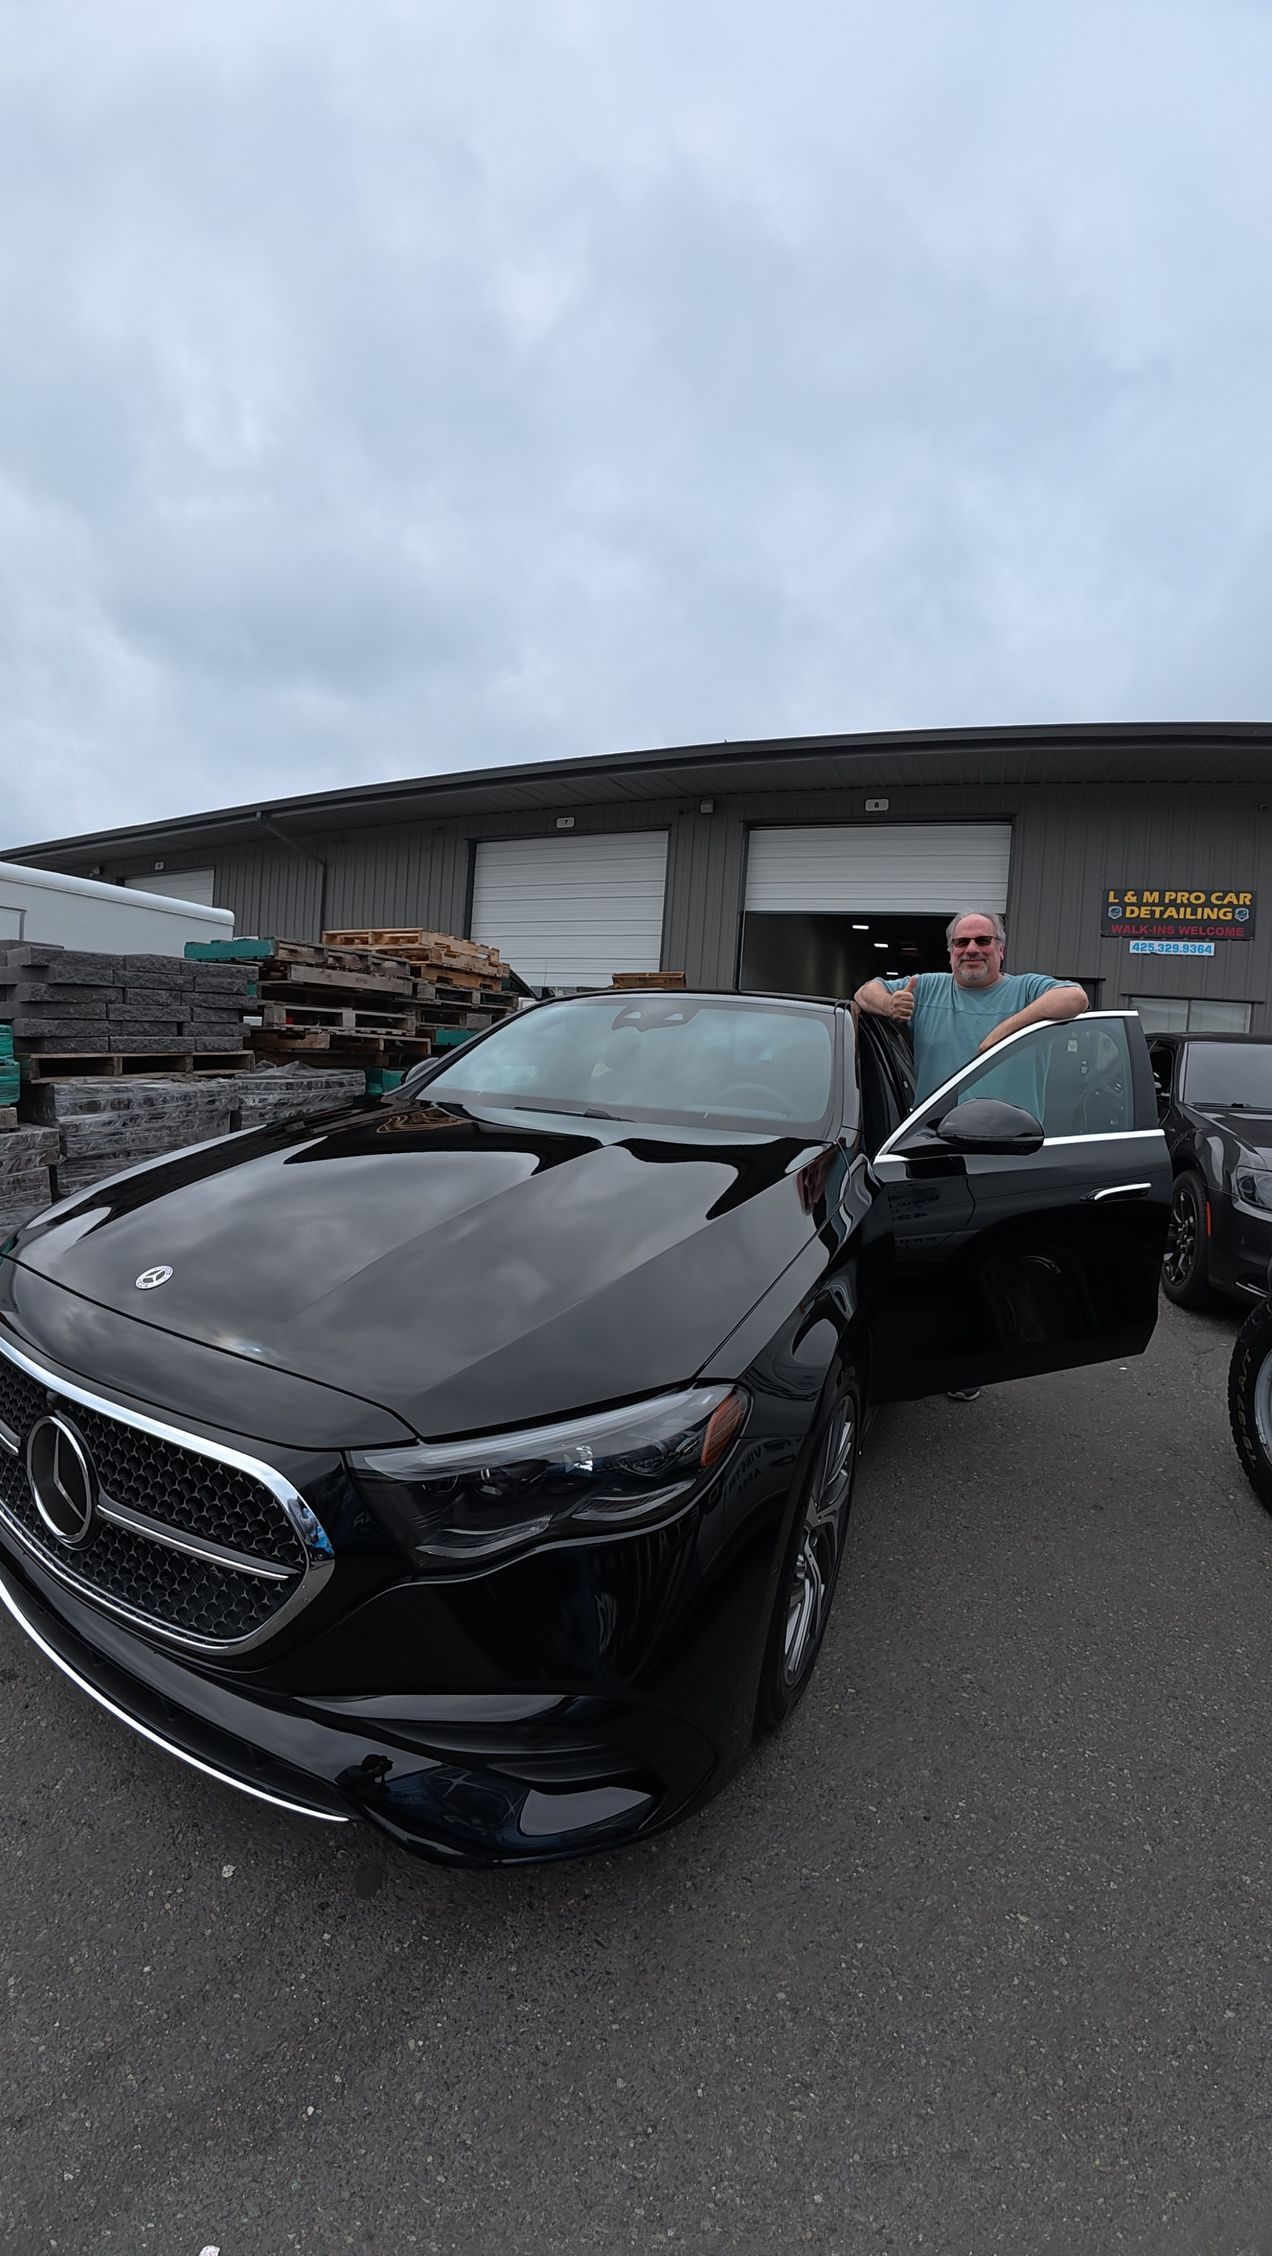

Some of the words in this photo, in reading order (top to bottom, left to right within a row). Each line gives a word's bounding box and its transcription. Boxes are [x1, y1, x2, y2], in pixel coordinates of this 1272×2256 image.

[1108, 890, 1120, 903] L
[1124, 891, 1138, 903] &
[1142, 891, 1160, 903] M
[1164, 891, 1206, 904] PRO
[1210, 892, 1252, 905] CAR
[1125, 906, 1233, 920] DETAILING
[1111, 924, 1175, 935] WALK-INS
[1178, 925, 1245, 937] WELCOME
[1132, 942, 1212, 954] 425.329.9364
